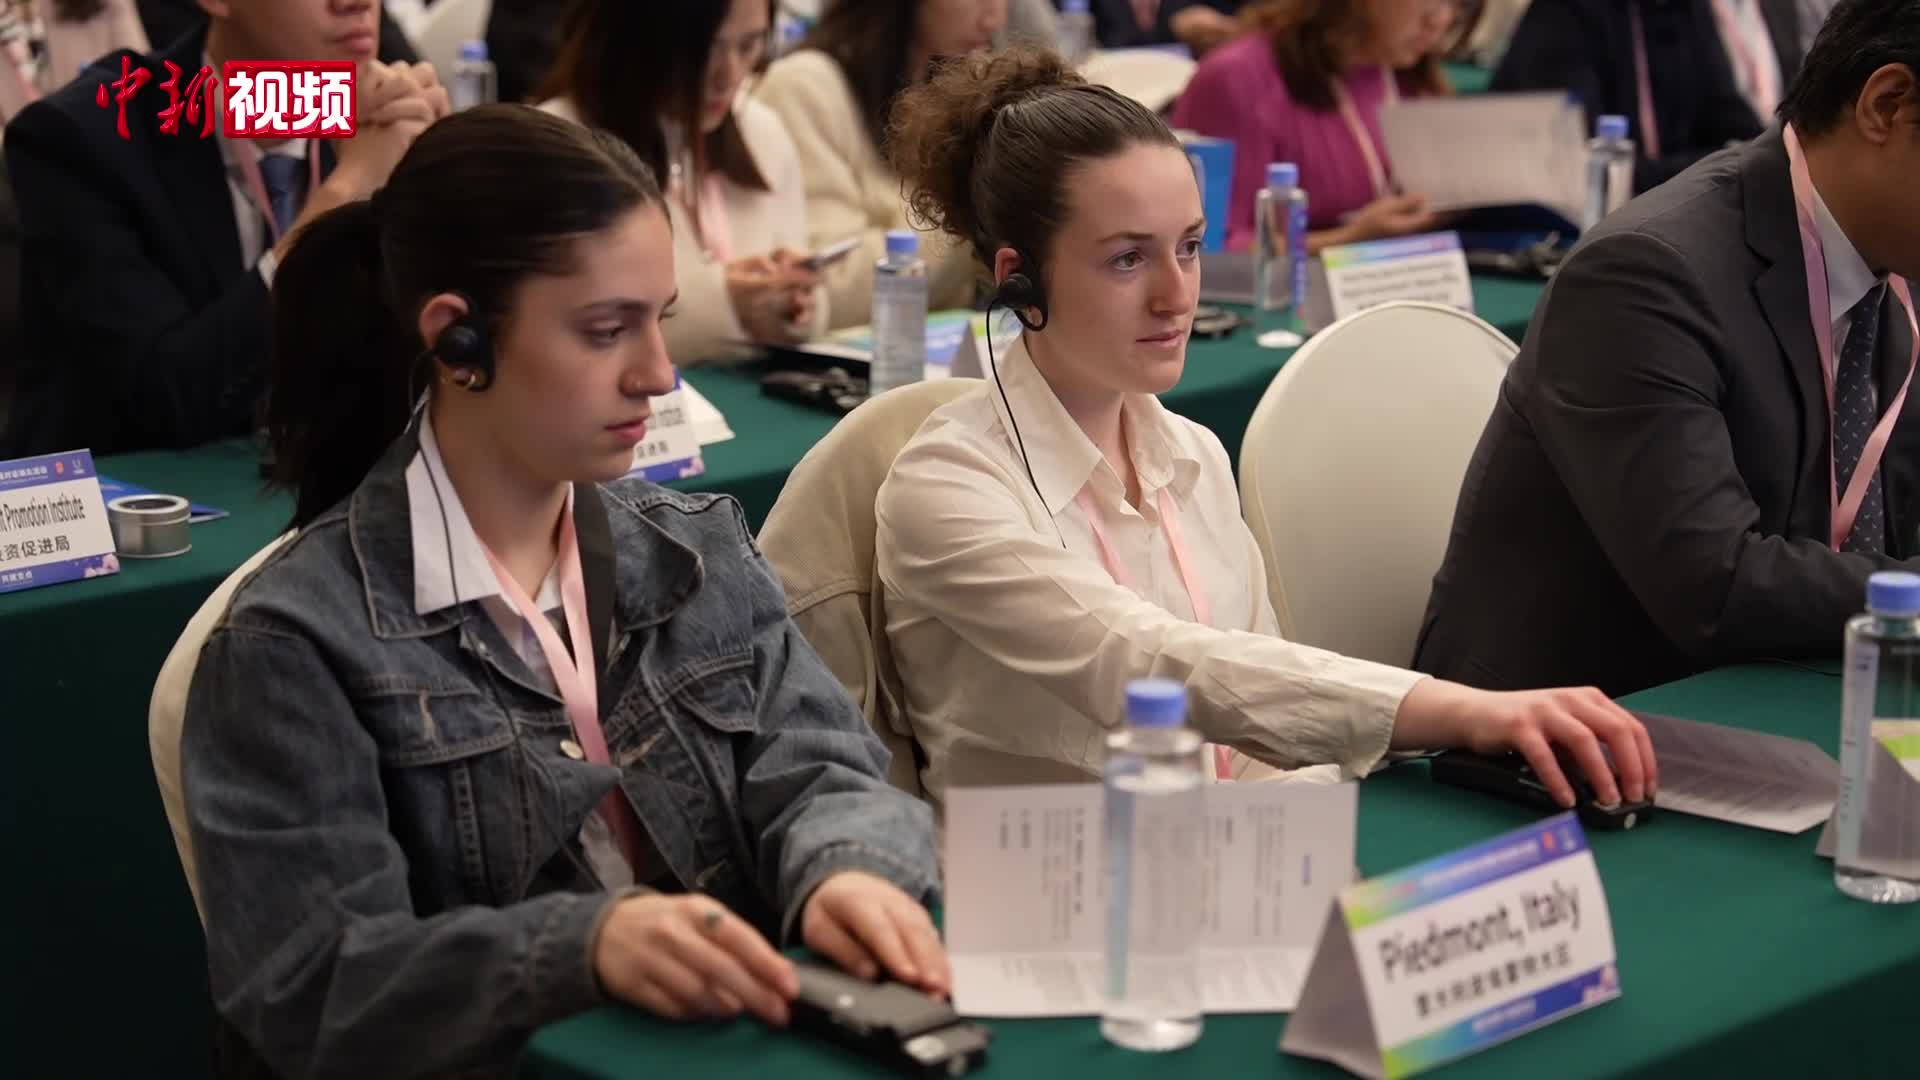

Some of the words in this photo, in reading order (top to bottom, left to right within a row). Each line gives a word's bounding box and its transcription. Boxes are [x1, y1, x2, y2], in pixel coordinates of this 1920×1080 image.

[4, 497, 51, 531] Promotion
[48, 492, 86, 523] Institute
[1380, 904, 1524, 981] Piedmont,
[1520, 880, 1580, 932] Italy
